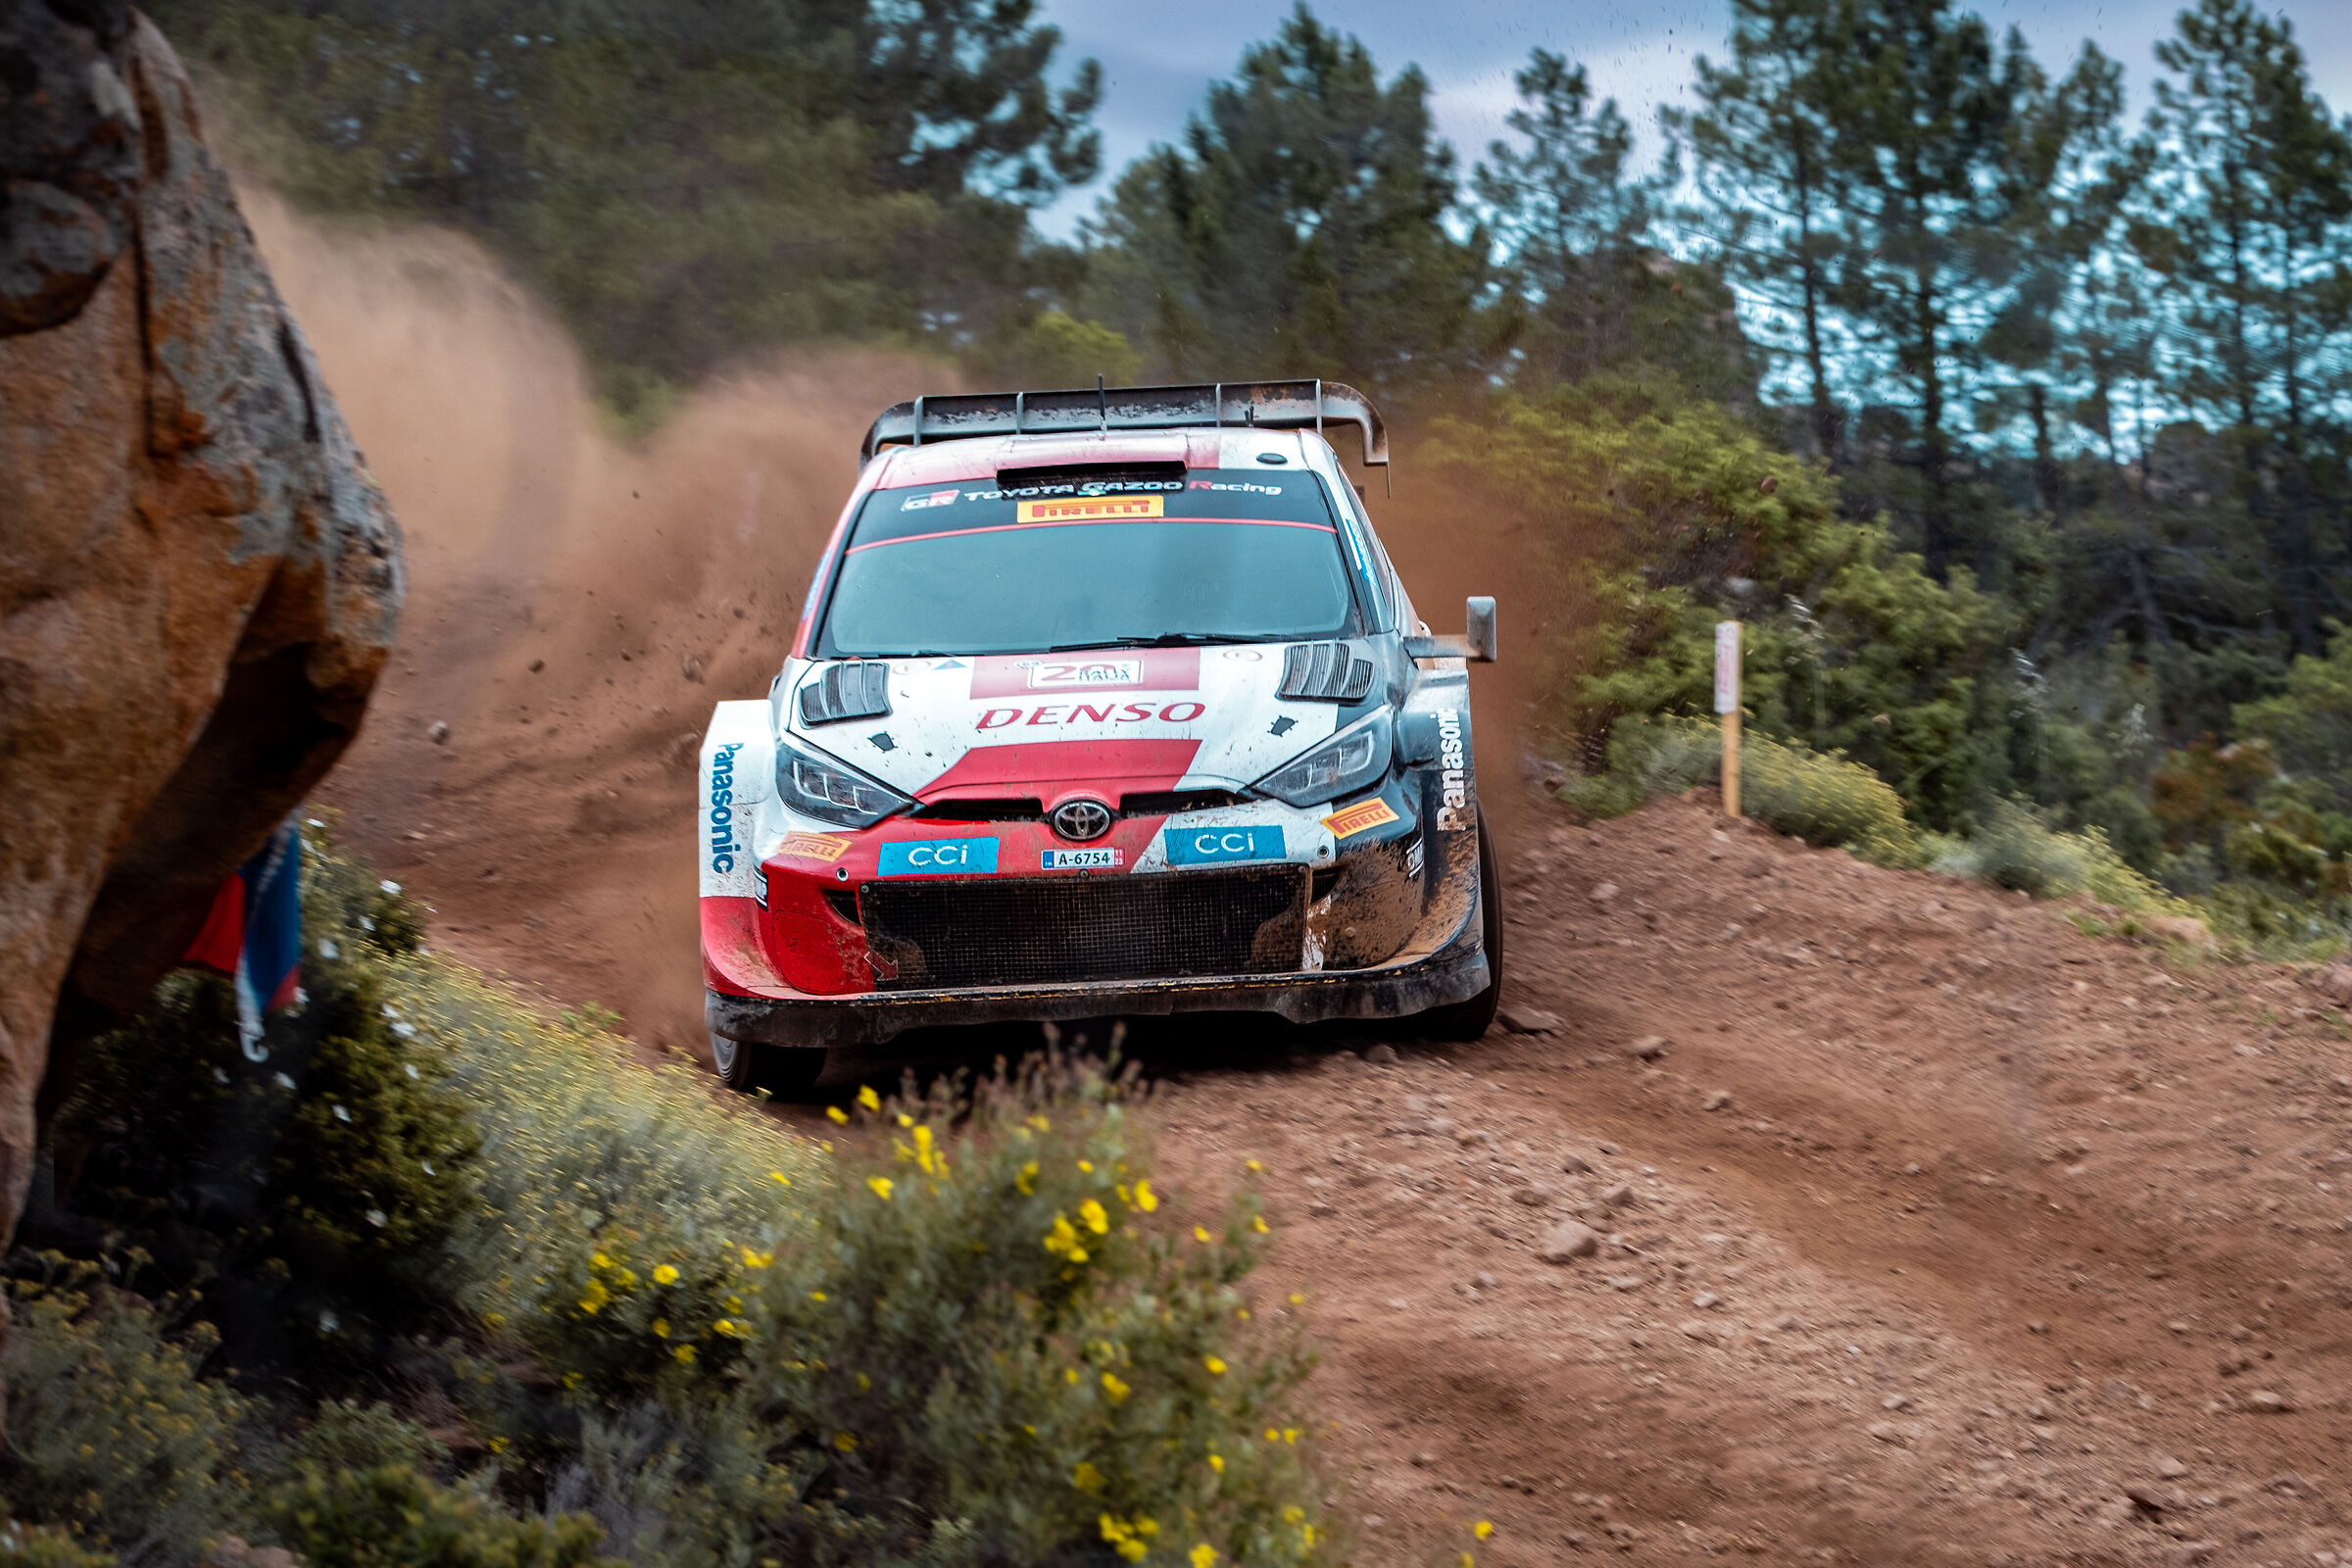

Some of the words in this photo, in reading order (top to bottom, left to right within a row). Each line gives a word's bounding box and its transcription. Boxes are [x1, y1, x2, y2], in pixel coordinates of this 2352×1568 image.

[903, 493, 957, 510] GR
[964, 485, 1074, 501] TOYOTA
[1081, 481, 1183, 494] GAZOO
[1189, 480, 1283, 495] Racing
[1032, 500, 1151, 517] PIRELLI
[975, 703, 1205, 729] DENSO
[1429, 708, 1466, 831] Panasonic
[710, 742, 745, 874] Panasonic
[1328, 804, 1391, 833] PIRELLI
[780, 834, 843, 857] PIRELLI
[1058, 852, 1110, 865] A-6754
